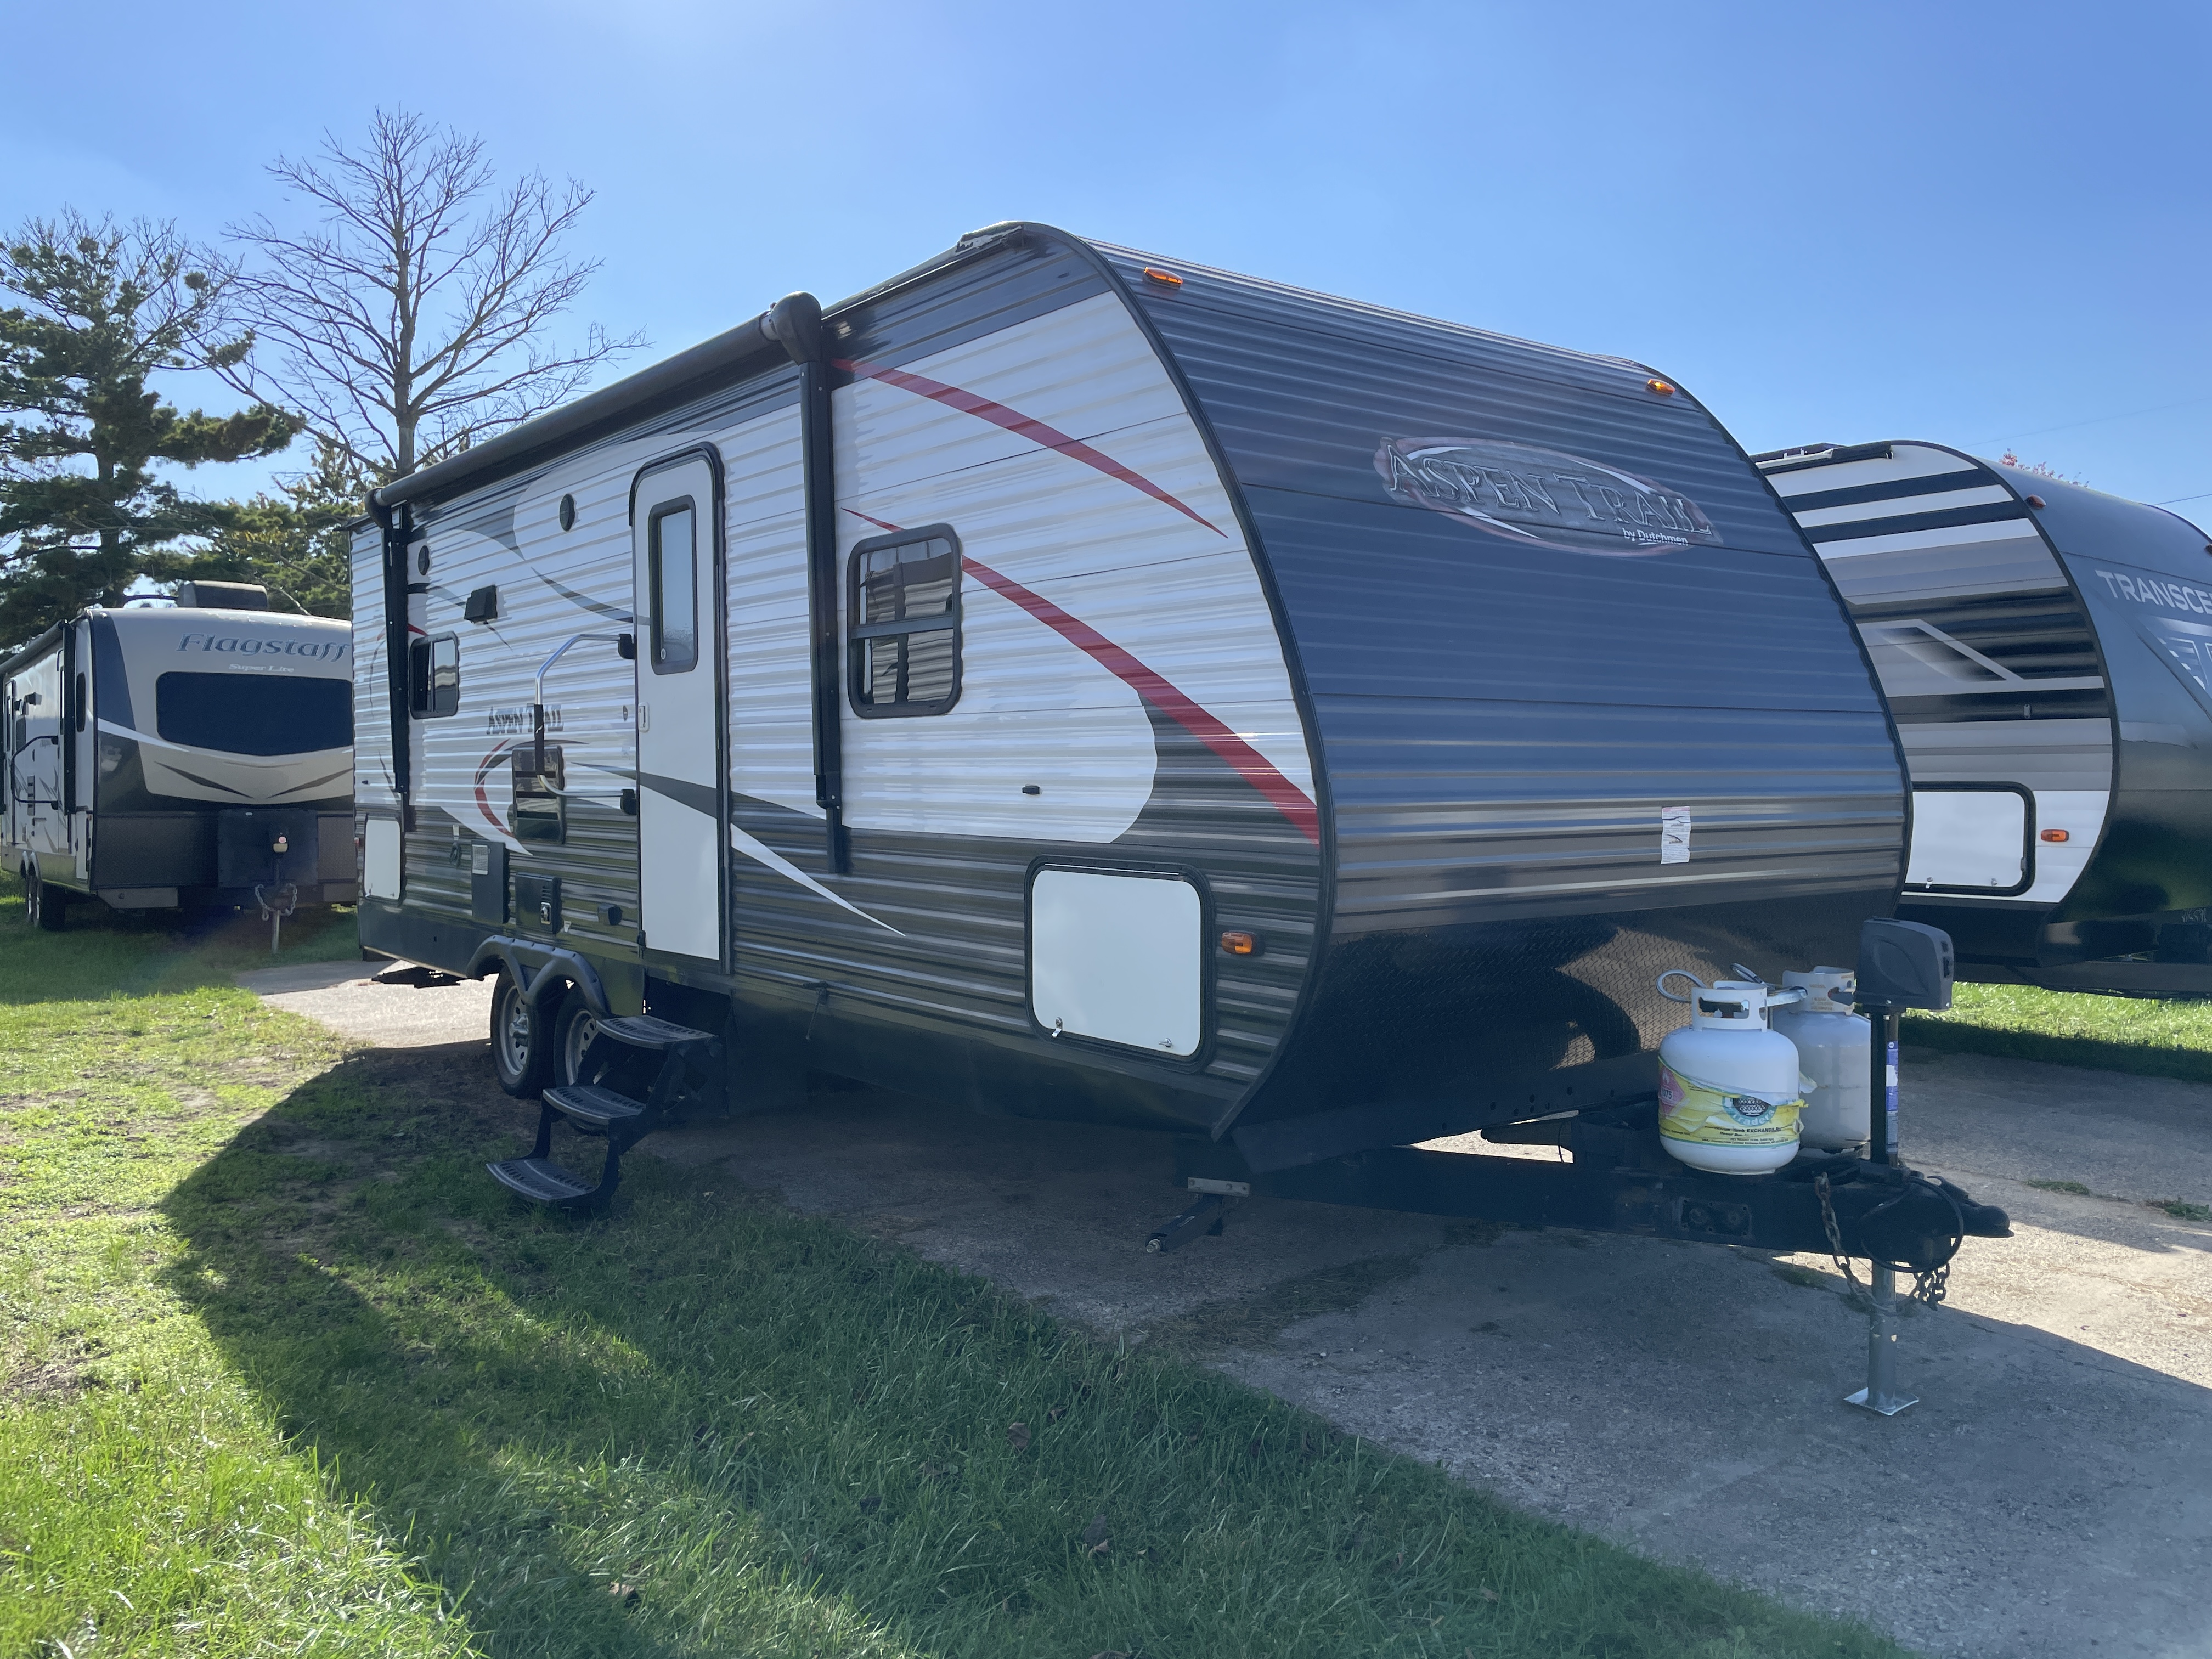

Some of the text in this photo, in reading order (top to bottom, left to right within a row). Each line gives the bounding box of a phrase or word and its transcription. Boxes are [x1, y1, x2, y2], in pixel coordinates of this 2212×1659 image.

[1387, 443, 1712, 535] ASPEN TRAIL
[1622, 527, 1689, 546] by Dutchmen
[2095, 569, 2212, 614] TRANSCE
[176, 633, 350, 663] Flagstaff
[228, 663, 266, 672] Super
[526, 703, 564, 733] TAIL
[1662, 1088, 1672, 1099] 075
